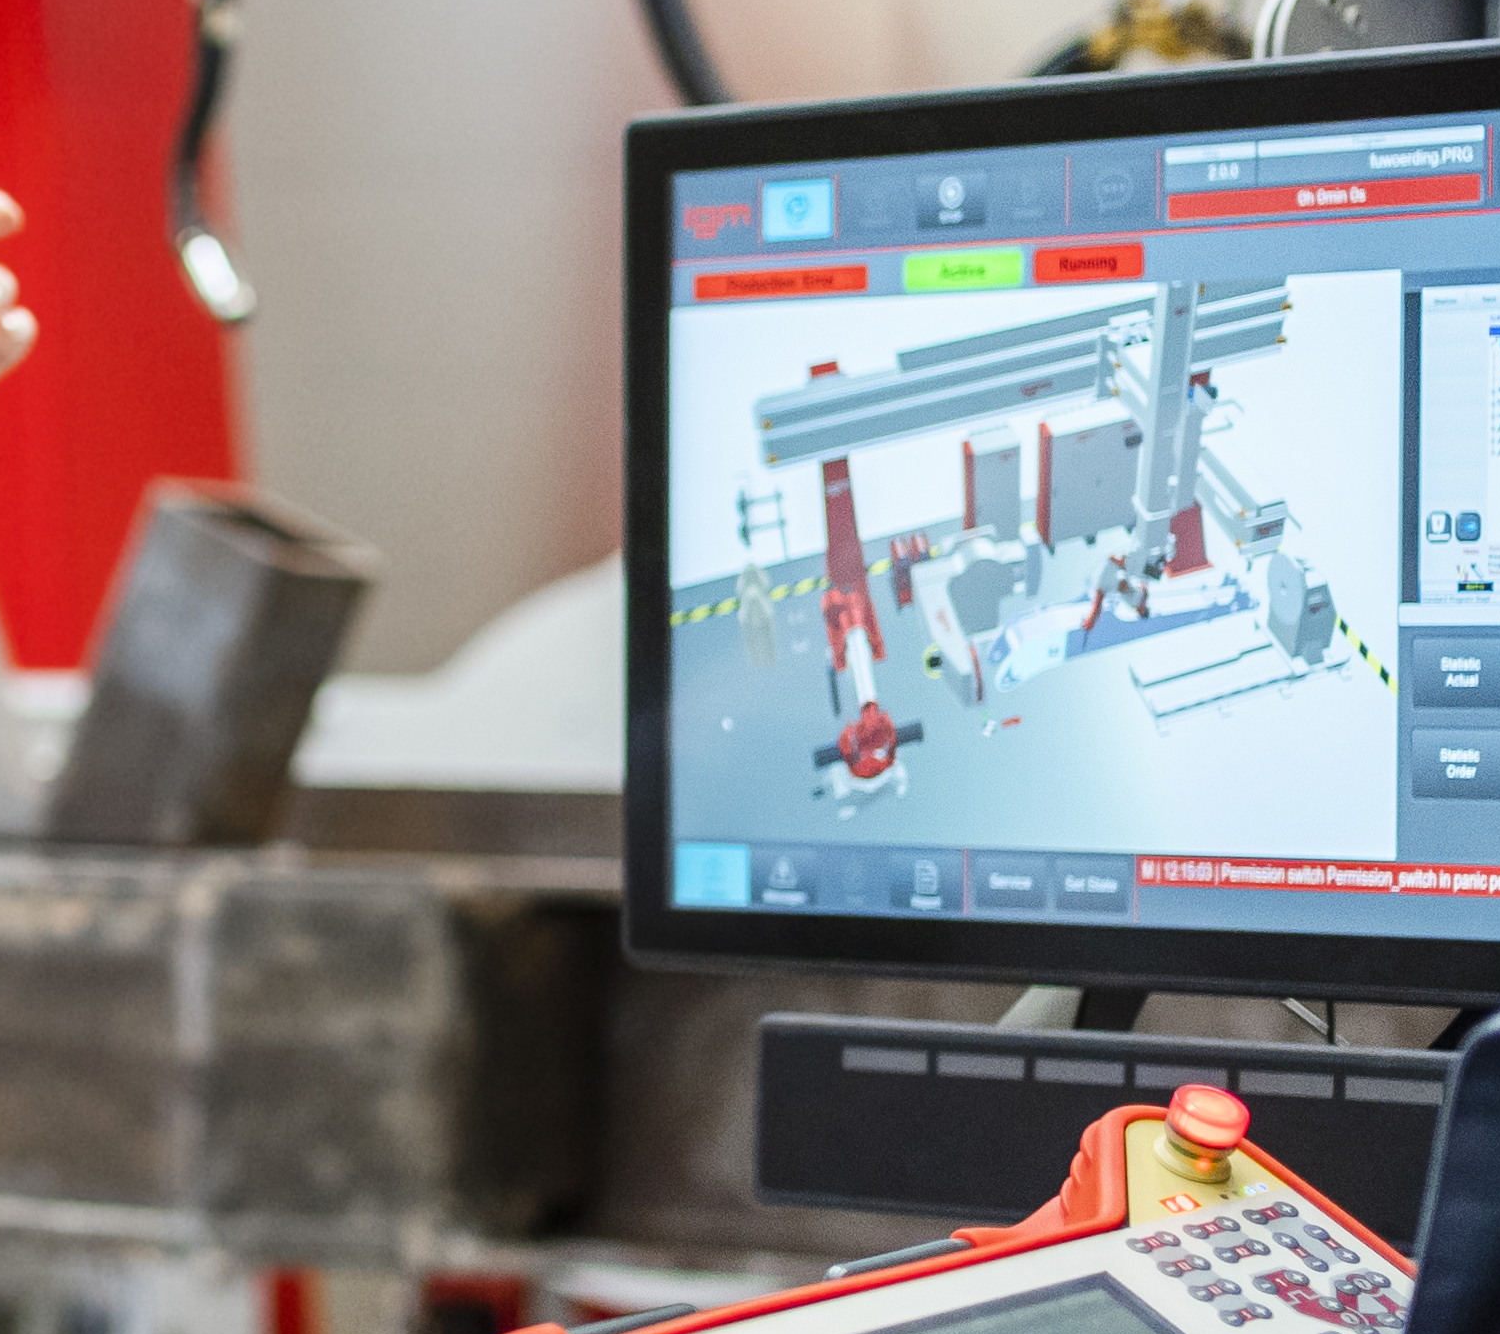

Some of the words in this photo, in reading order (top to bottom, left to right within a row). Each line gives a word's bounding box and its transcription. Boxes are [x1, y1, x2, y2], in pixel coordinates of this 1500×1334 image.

[1059, 256, 1117, 274] Running
[1444, 672, 1480, 688] Actual
[1445, 763, 1477, 779] Order
[1221, 862, 1285, 884] Permission
[1287, 865, 1325, 885] switch
[1439, 869, 1451, 888] in
[1453, 870, 1488, 891] panic
